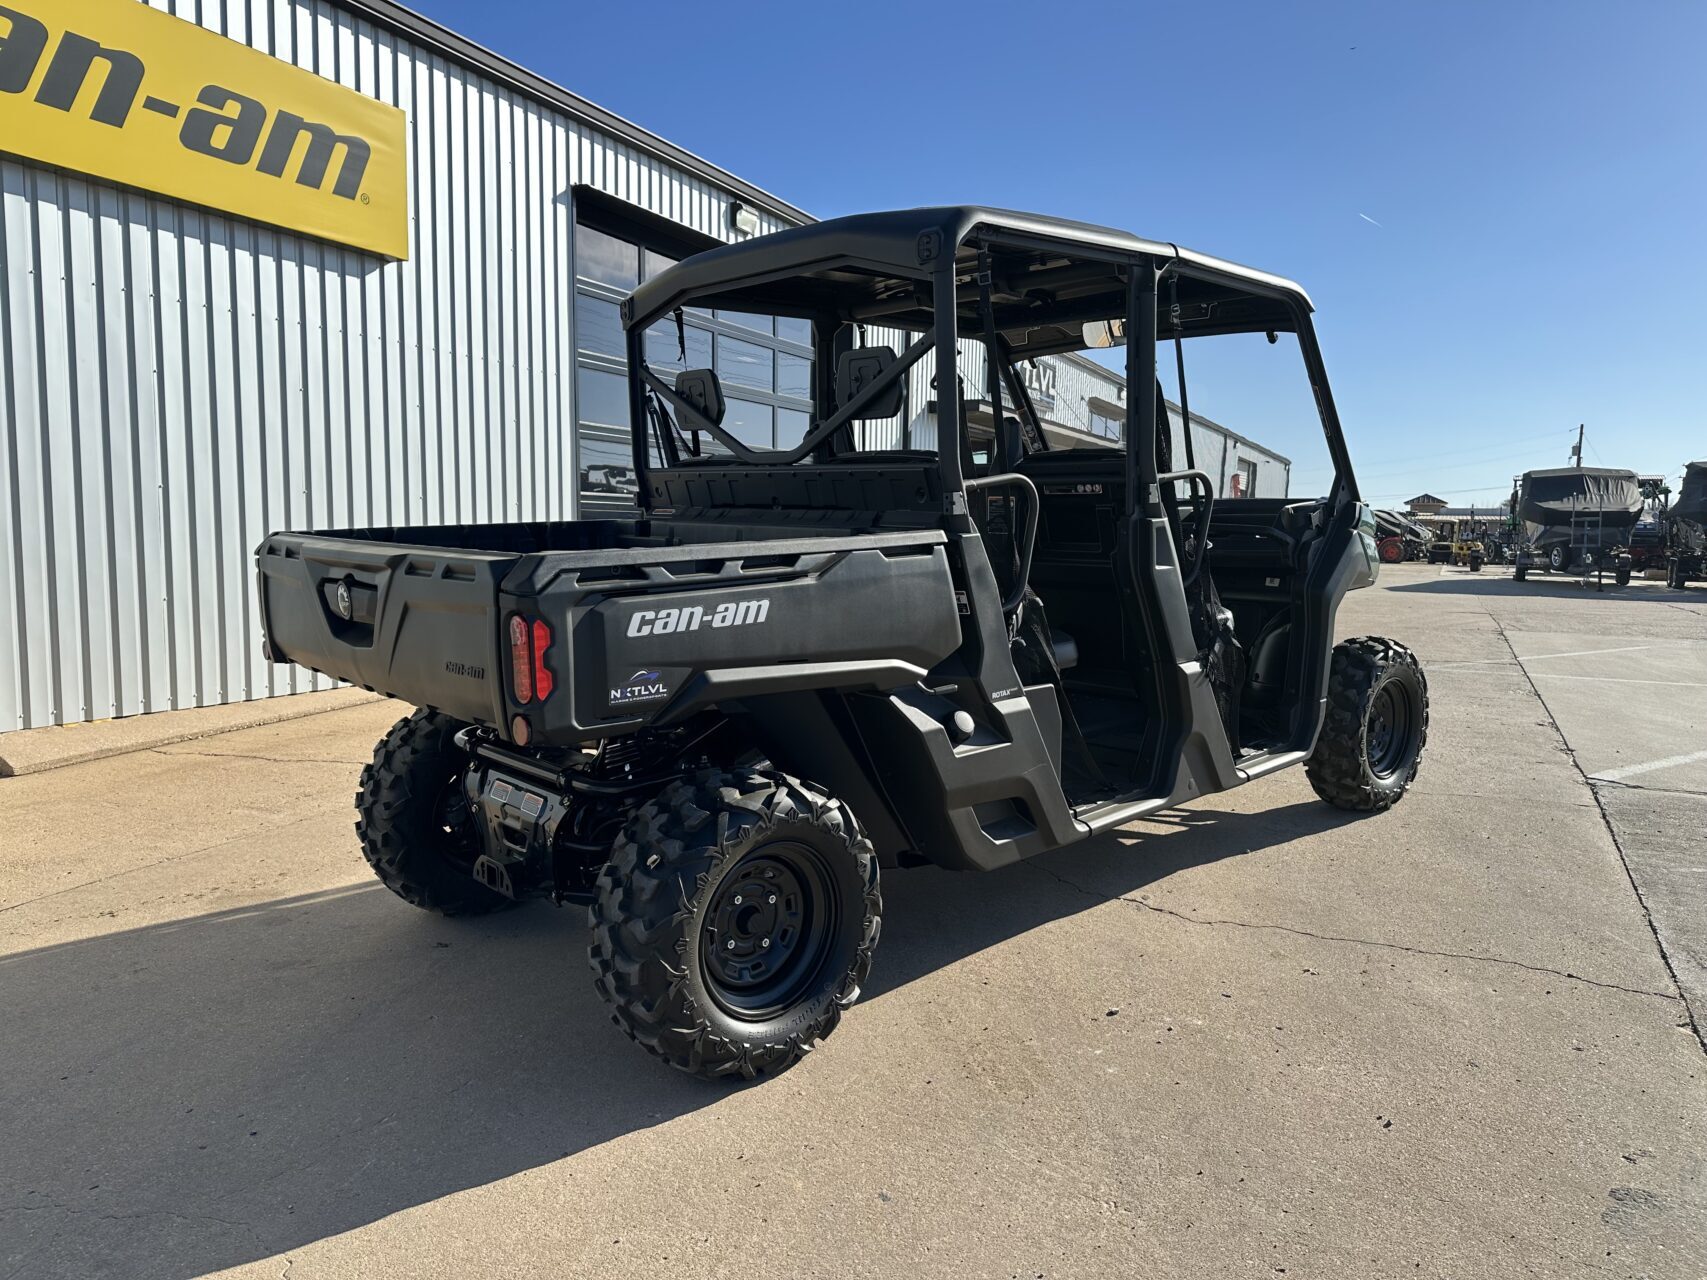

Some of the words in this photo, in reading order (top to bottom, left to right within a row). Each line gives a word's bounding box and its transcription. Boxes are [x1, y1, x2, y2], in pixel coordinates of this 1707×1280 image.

[1022, 359, 1056, 396] TLVL
[626, 598, 770, 638] can-am
[610, 683, 668, 699] NXTLVL
[992, 689, 1010, 699] ROTAX
